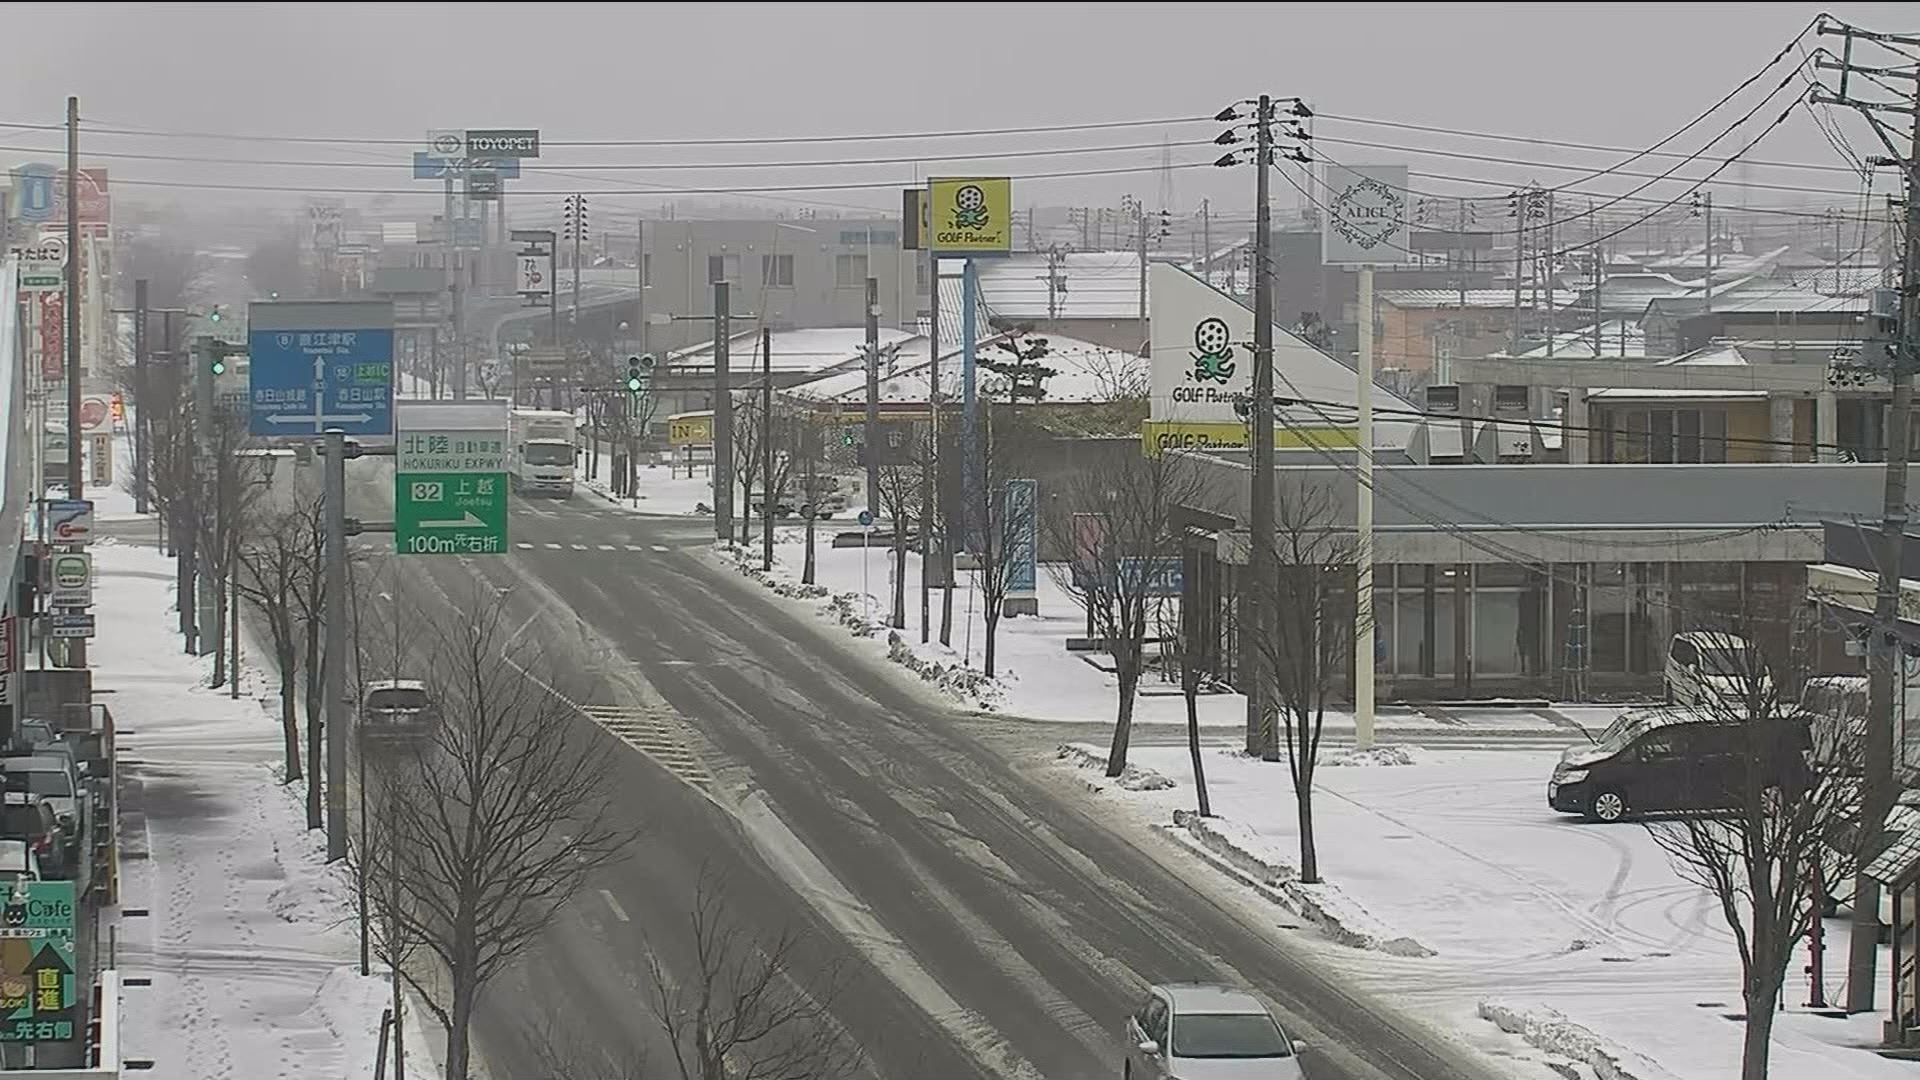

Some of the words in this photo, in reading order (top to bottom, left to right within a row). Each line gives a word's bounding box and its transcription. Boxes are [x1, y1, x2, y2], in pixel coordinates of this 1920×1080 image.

[470, 137, 535, 151] TOYOPET
[1347, 207, 1388, 218] ALICE
[937, 232, 963, 243] GOLF
[281, 335, 289, 345] 8
[1172, 386, 1204, 403] GOLF
[672, 425, 690, 438] IN
[405, 435, 448, 454] 北陸
[455, 441, 502, 454] 自動車道
[403, 458, 460, 470] HOKURIKU
[465, 458, 503, 469] EXPWY
[415, 483, 440, 500] 32
[454, 479, 495, 496] 上越
[29, 900, 71, 917] Cafe
[37, 968, 60, 1011] 直進
